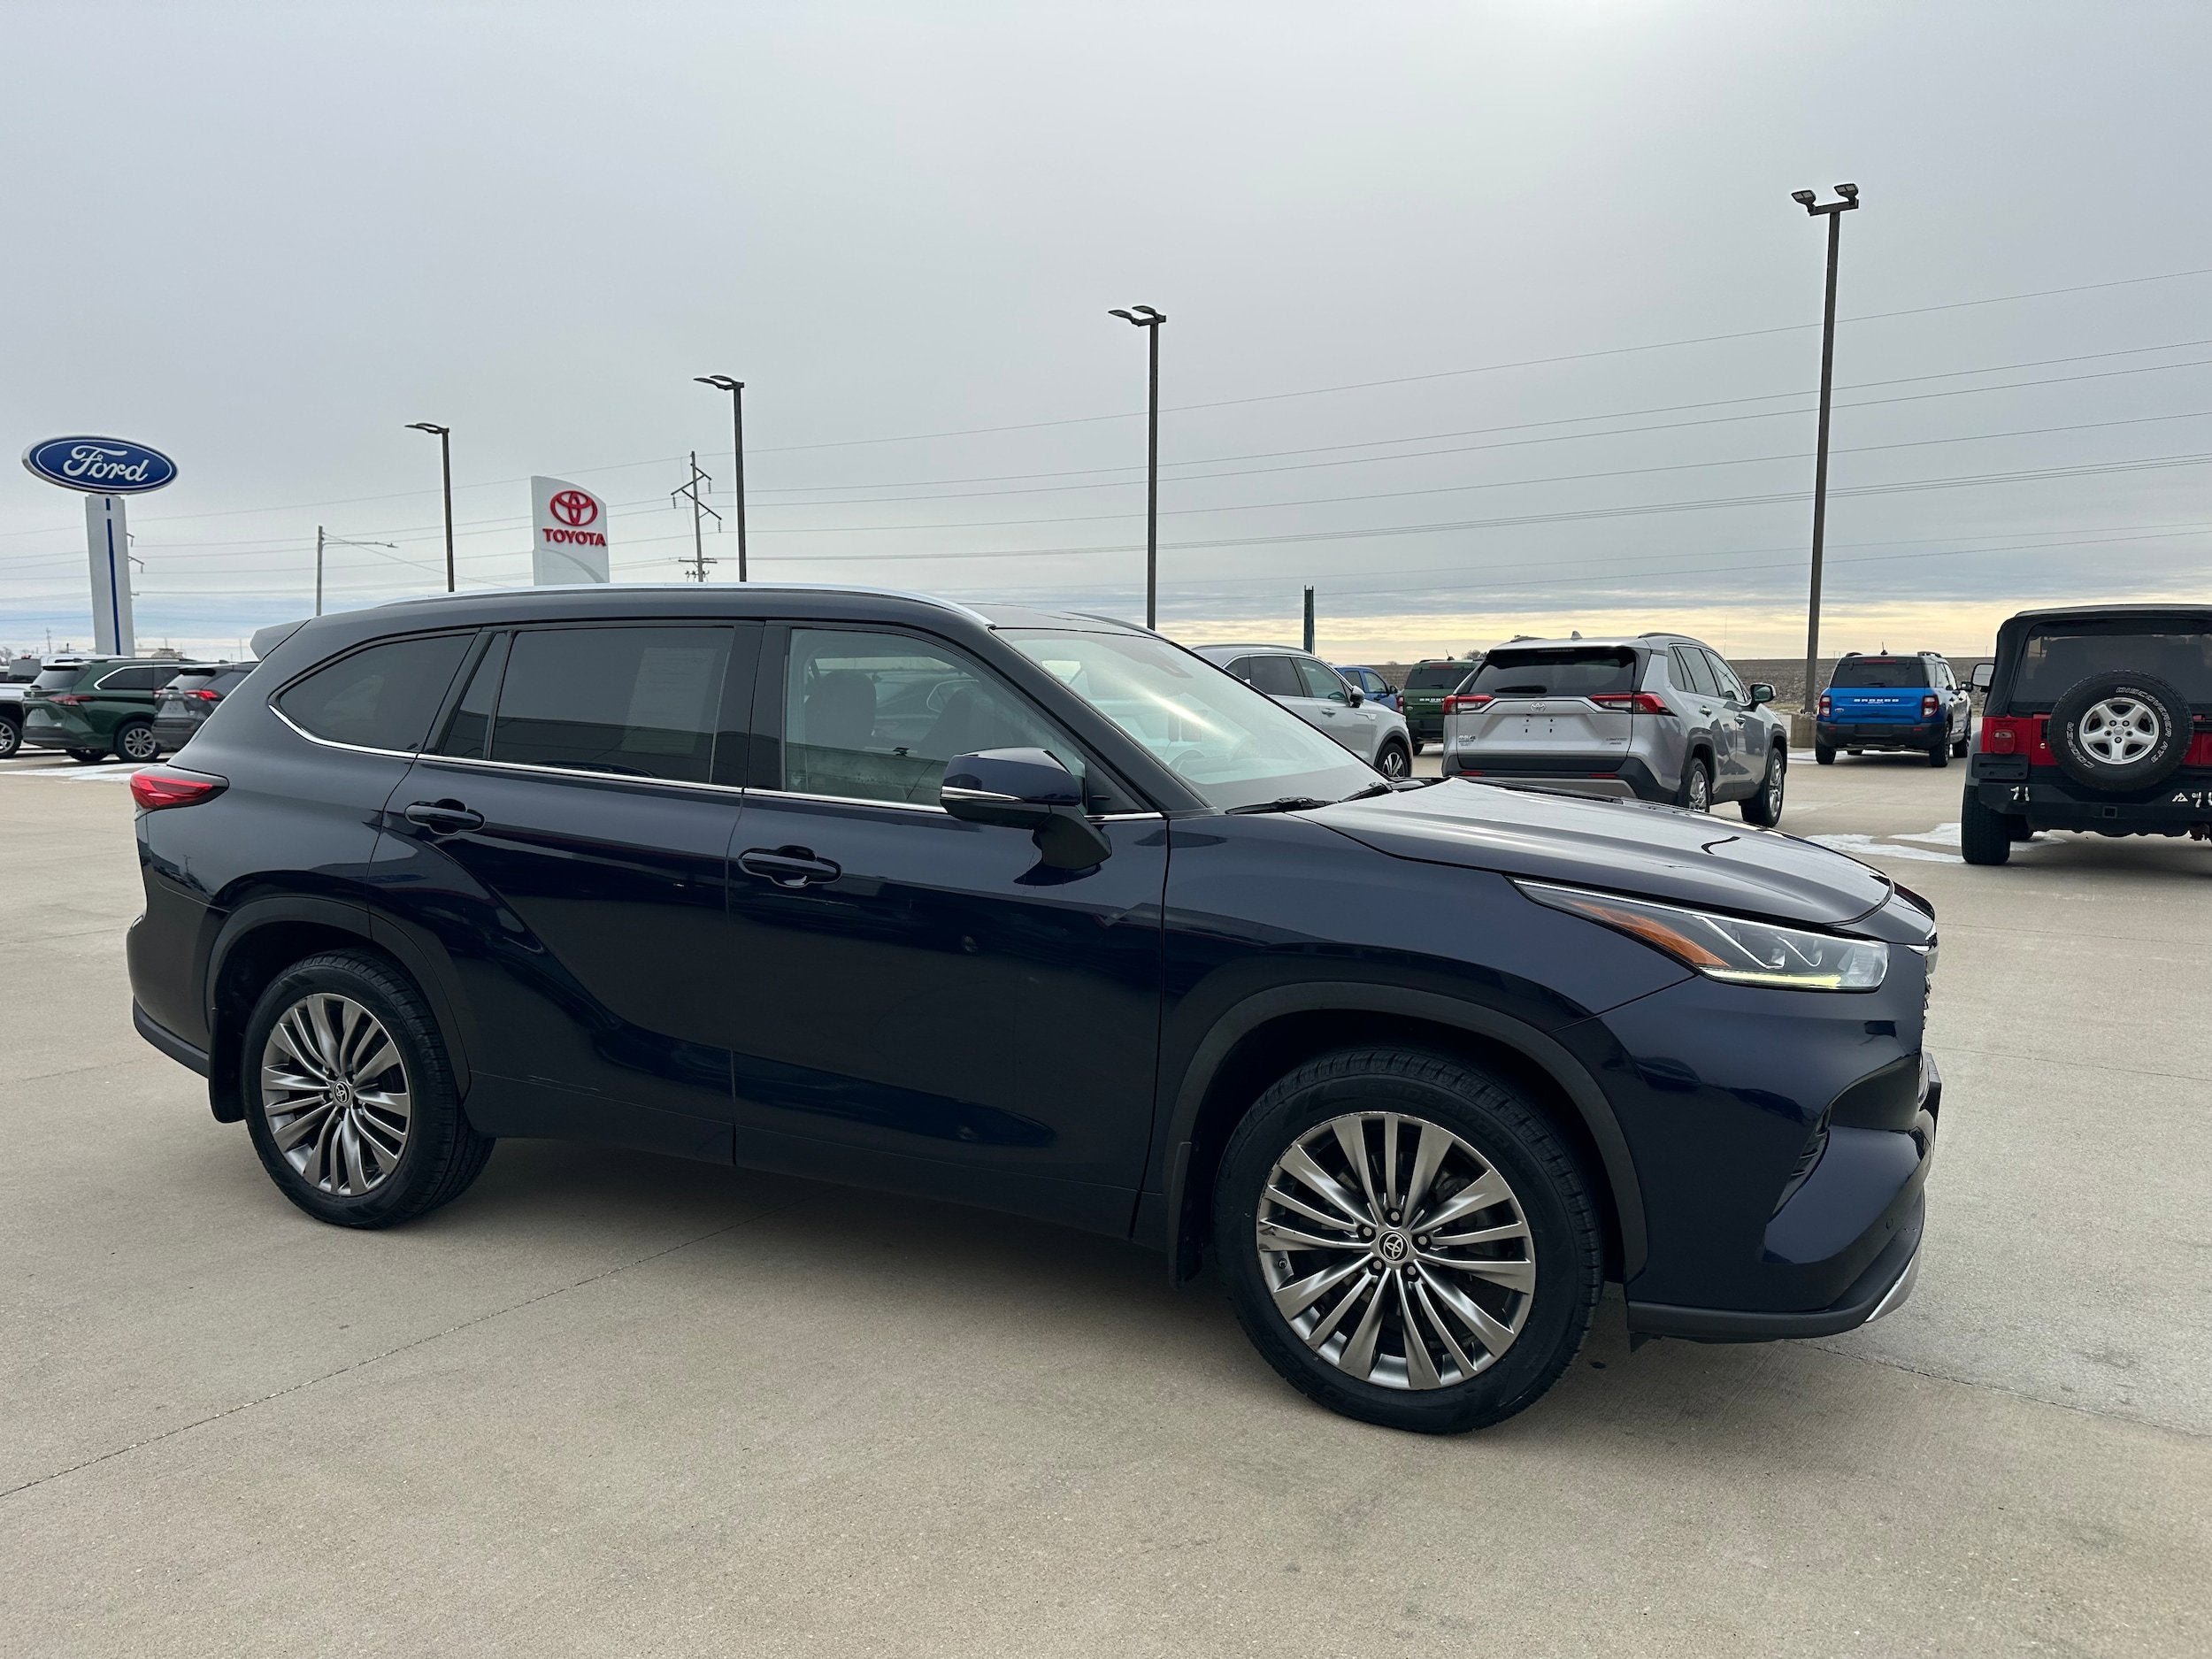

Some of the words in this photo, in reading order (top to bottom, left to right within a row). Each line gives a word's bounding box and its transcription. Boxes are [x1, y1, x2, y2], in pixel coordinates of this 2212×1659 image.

[63, 445, 149, 481] Ford
[542, 528, 606, 547] TOYOTA
[2116, 687, 2172, 738] DISCOVERER
[2066, 721, 2094, 769] COOPER
